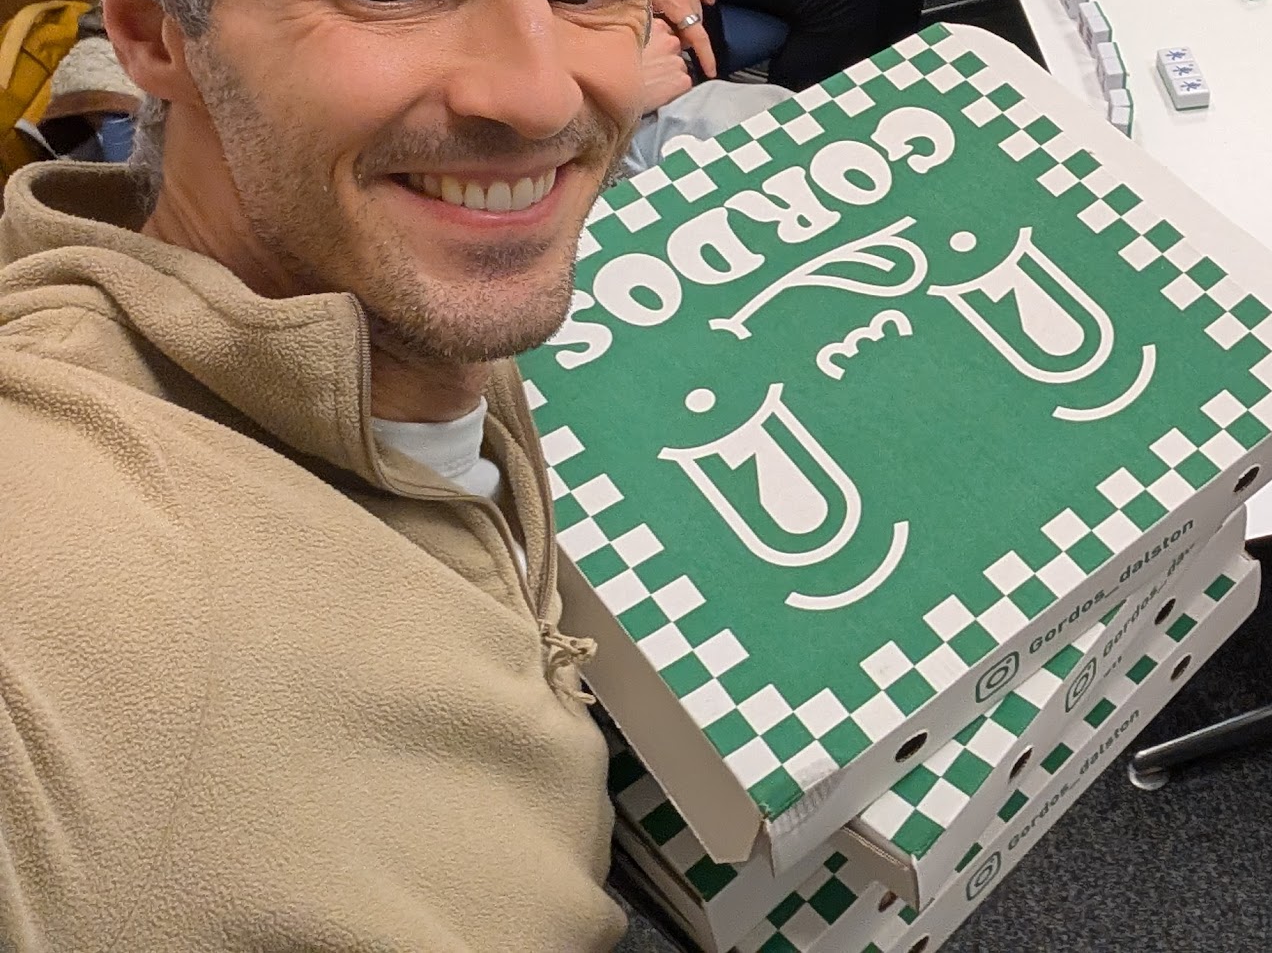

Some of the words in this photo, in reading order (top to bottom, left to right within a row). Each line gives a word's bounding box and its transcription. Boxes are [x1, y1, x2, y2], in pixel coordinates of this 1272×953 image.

[549, 106, 956, 372] GORDOS
[1028, 519, 1195, 655] Gordos_dalston
[1007, 708, 1141, 852] Gordos_dalston
